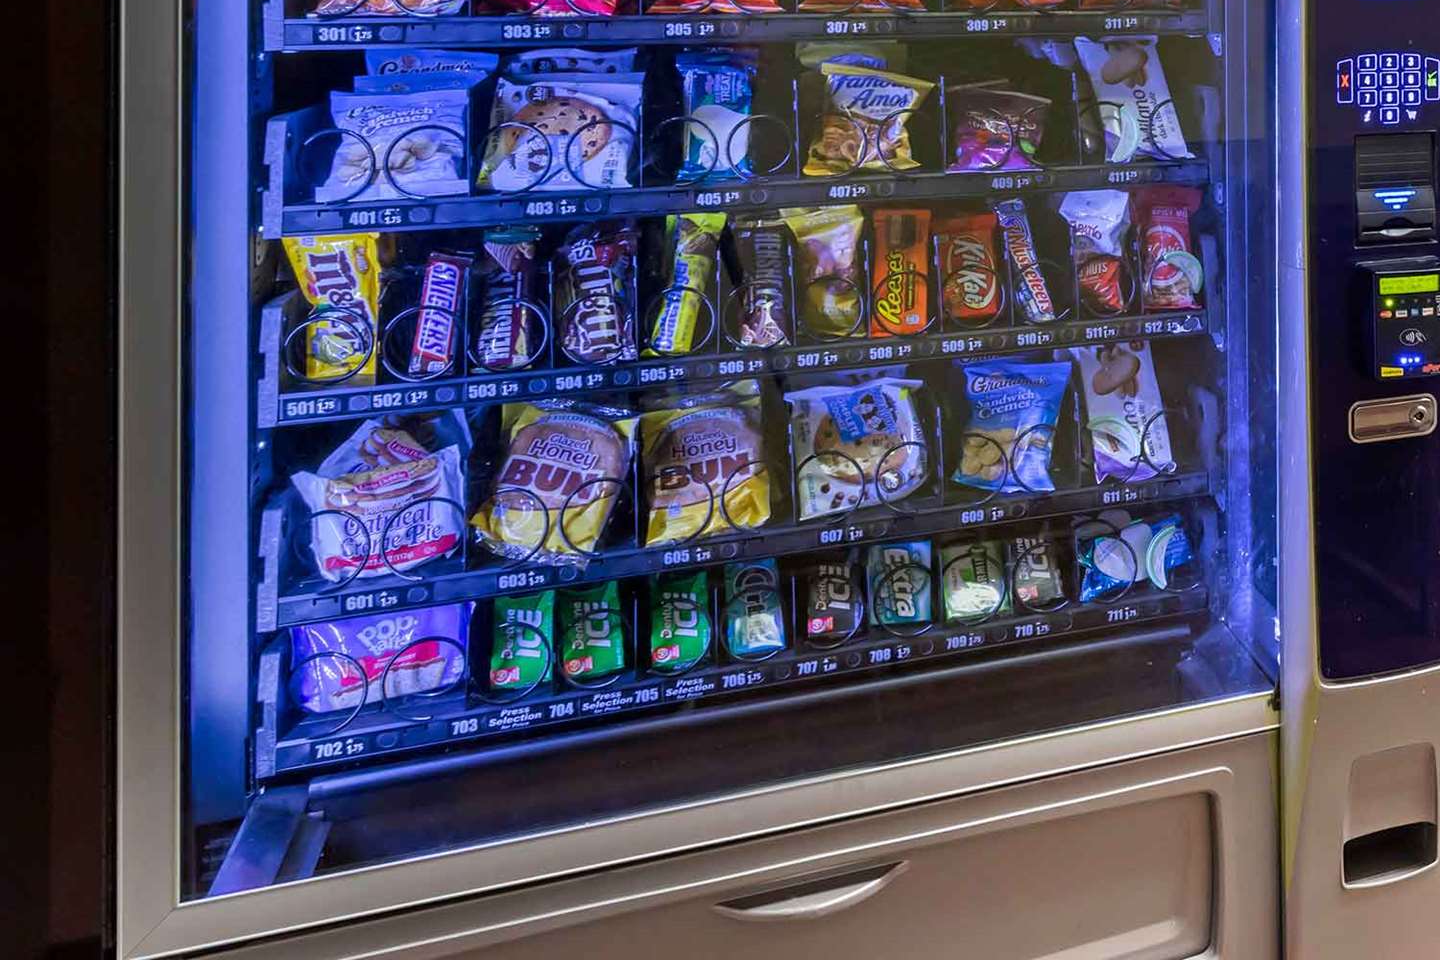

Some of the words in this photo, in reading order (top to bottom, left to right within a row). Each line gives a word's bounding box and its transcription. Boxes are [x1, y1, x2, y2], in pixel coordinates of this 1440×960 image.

[666, 23, 692, 36] 305
[827, 22, 848, 33] 307
[1105, 18, 1121, 29] 311
[319, 28, 346, 41] 301
[504, 25, 531, 39] 303
[1365, 58, 1370, 67] 1
[1386, 58, 1392, 67] 2
[1408, 58, 1414, 67] 3
[1364, 76, 1370, 85] 4
[1386, 76, 1392, 85] 5
[1408, 75, 1414, 84] 6
[850, 90, 909, 108] Amos
[1365, 94, 1370, 103] 7
[1386, 93, 1392, 102] 8
[1408, 93, 1414, 102] 9
[1387, 111, 1393, 120] 0
[1108, 172, 1124, 183] 411
[696, 193, 721, 205] 405
[829, 186, 851, 198] 407
[526, 201, 554, 215] 403
[349, 211, 376, 225] 401
[953, 239, 985, 267] Kit
[876, 251, 905, 325] Reese's
[956, 269, 986, 307] Kat
[417, 263, 459, 356] SNICKERS
[1086, 327, 1103, 339] 511
[1145, 322, 1163, 334] 512
[942, 340, 965, 353] 509
[1017, 334, 1036, 346] 510
[797, 355, 820, 367] 507
[870, 348, 892, 360] 508
[719, 362, 744, 374] 506
[641, 370, 666, 382] 505
[556, 377, 582, 390] 504
[469, 384, 496, 398] 503
[373, 394, 402, 408] 502
[976, 390, 1036, 409] Sandwich
[287, 402, 314, 416] 501
[978, 399, 1032, 419] Cremes
[550, 433, 591, 454] Glazed
[671, 438, 738, 458] Honey
[528, 440, 599, 470] Honey
[659, 451, 750, 491] BUN
[504, 458, 601, 500] BUN
[1104, 492, 1120, 503] 611
[344, 503, 432, 537] Oatmeal
[961, 510, 984, 523] 609
[405, 523, 442, 549] Pie
[820, 529, 842, 542] 607
[664, 550, 690, 564] 605
[499, 573, 526, 588] 603
[828, 565, 850, 609] ICE
[346, 595, 373, 610] 601
[1107, 610, 1123, 621] 711
[517, 610, 542, 658] ICE
[1014, 626, 1033, 637] 710
[946, 636, 966, 648] 709
[869, 650, 891, 663] 708
[797, 661, 818, 674] 707
[676, 677, 703, 688] Press
[722, 673, 745, 687] 706
[593, 691, 621, 701] Press
[635, 688, 658, 702] 705
[665, 682, 714, 698] Selection
[550, 703, 574, 717] 704
[582, 696, 633, 712] Selection
[501, 707, 530, 717] Press
[489, 712, 542, 728] Selection
[452, 720, 478, 735] 703
[316, 744, 343, 758] 702
